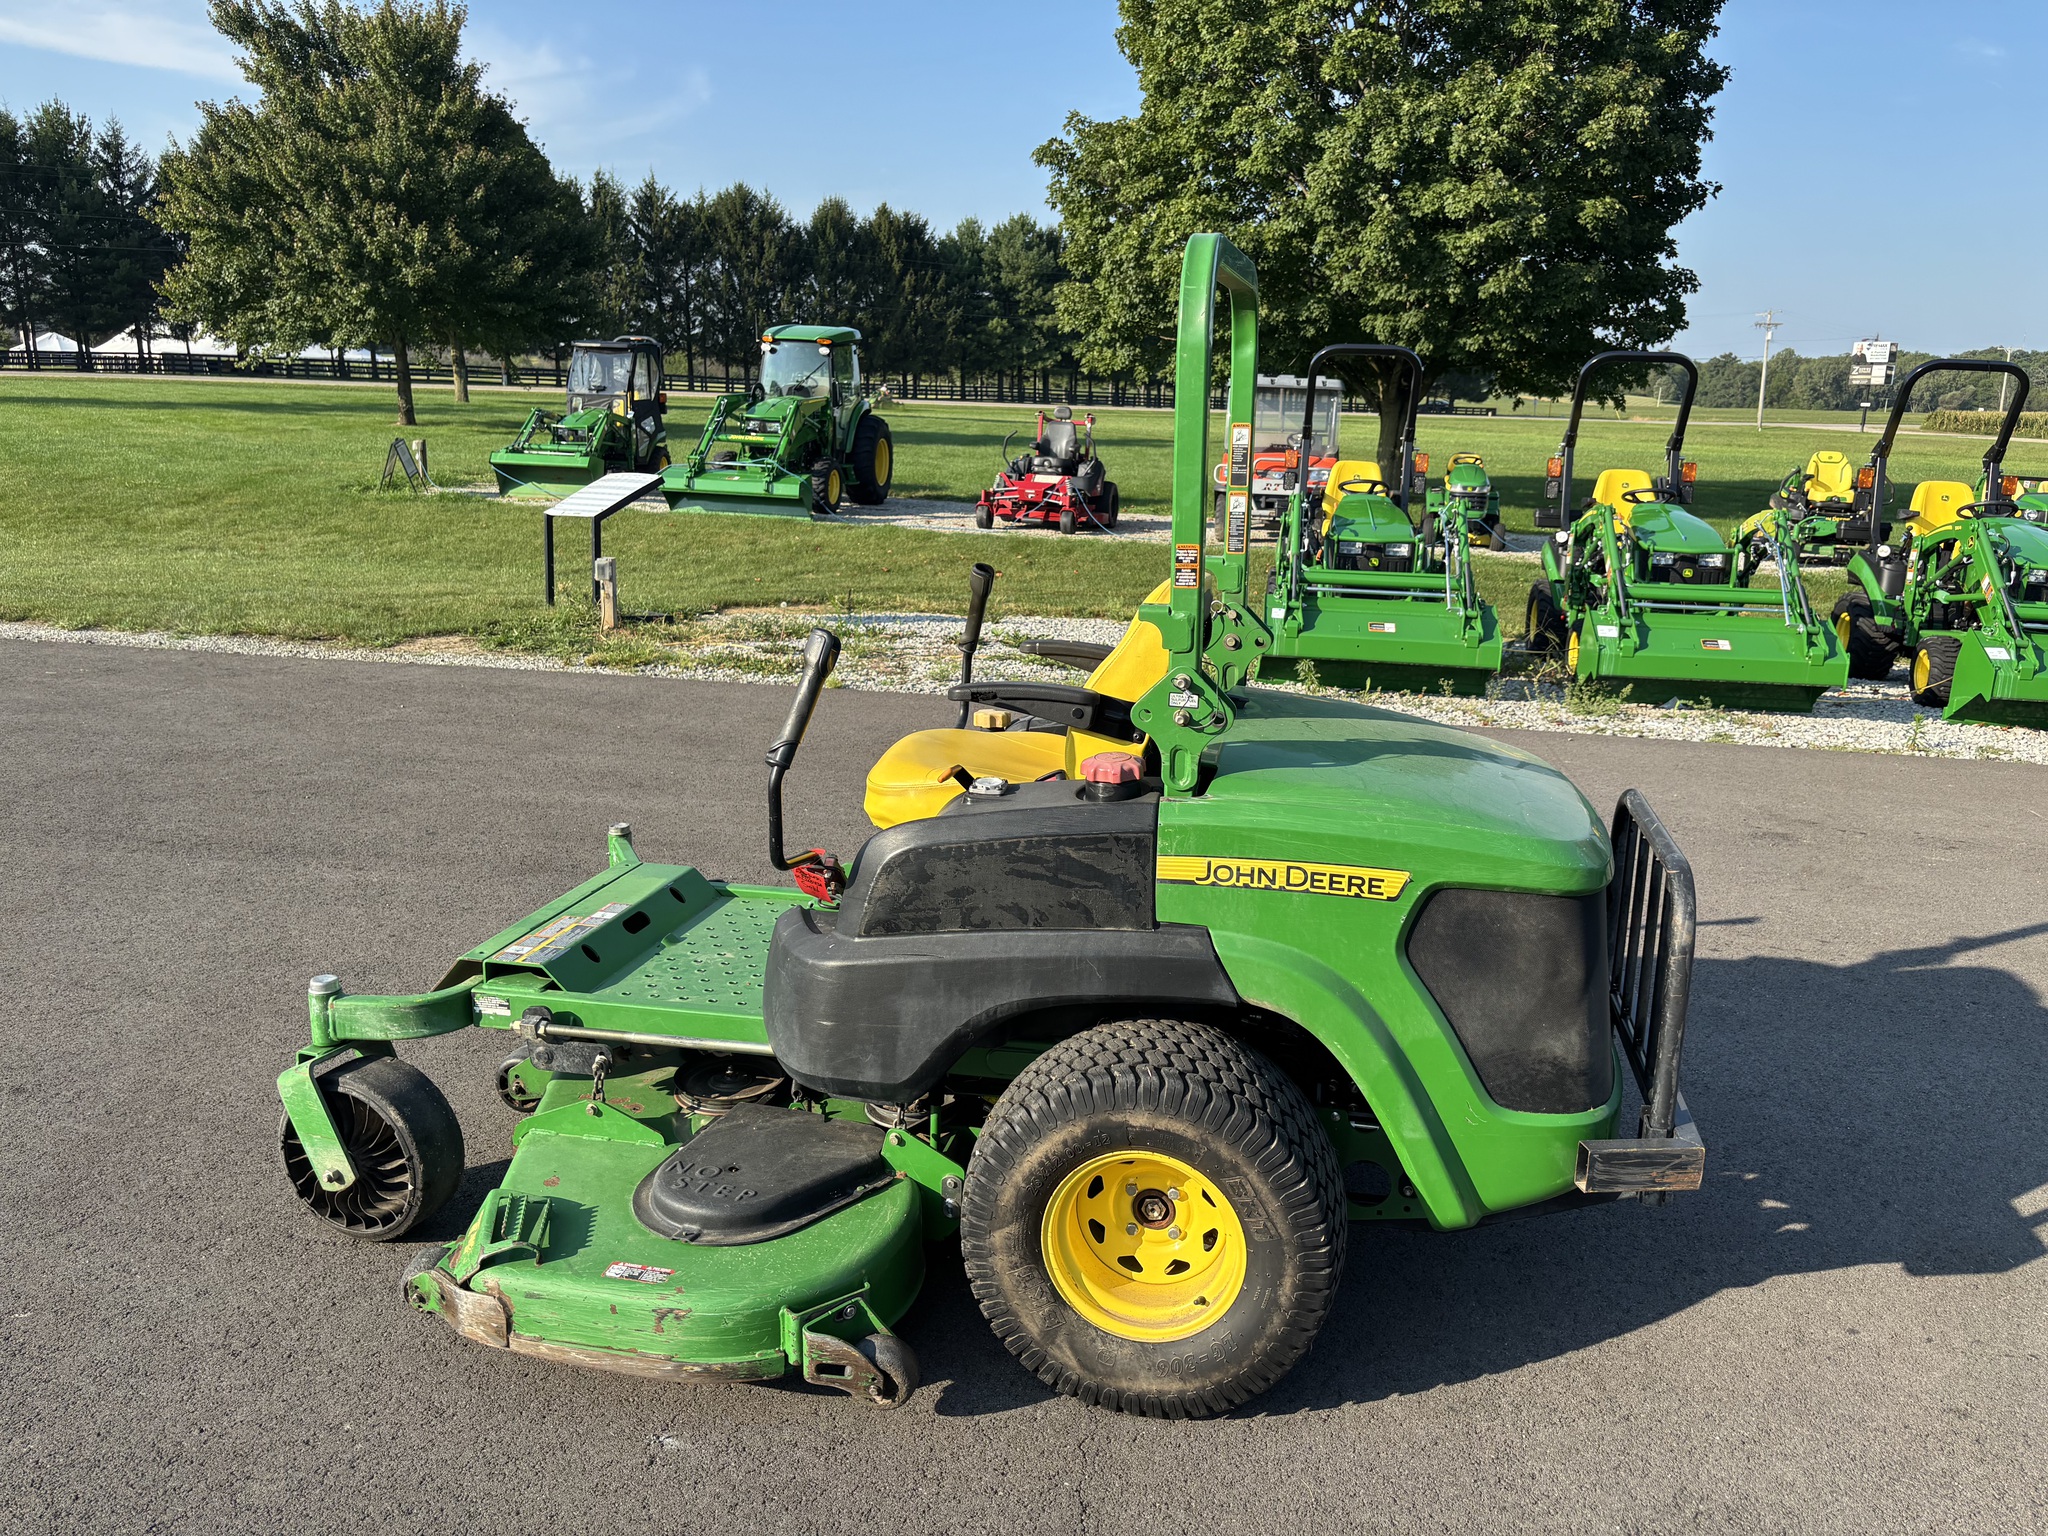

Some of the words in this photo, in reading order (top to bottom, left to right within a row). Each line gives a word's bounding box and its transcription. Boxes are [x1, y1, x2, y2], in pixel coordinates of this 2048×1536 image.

[1195, 860, 1277, 886] JOHN
[1285, 865, 1385, 896] DEERE
[664, 1160, 723, 1179] NO
[671, 1176, 758, 1202] STEP
[1155, 1330, 1238, 1378] LG-306
